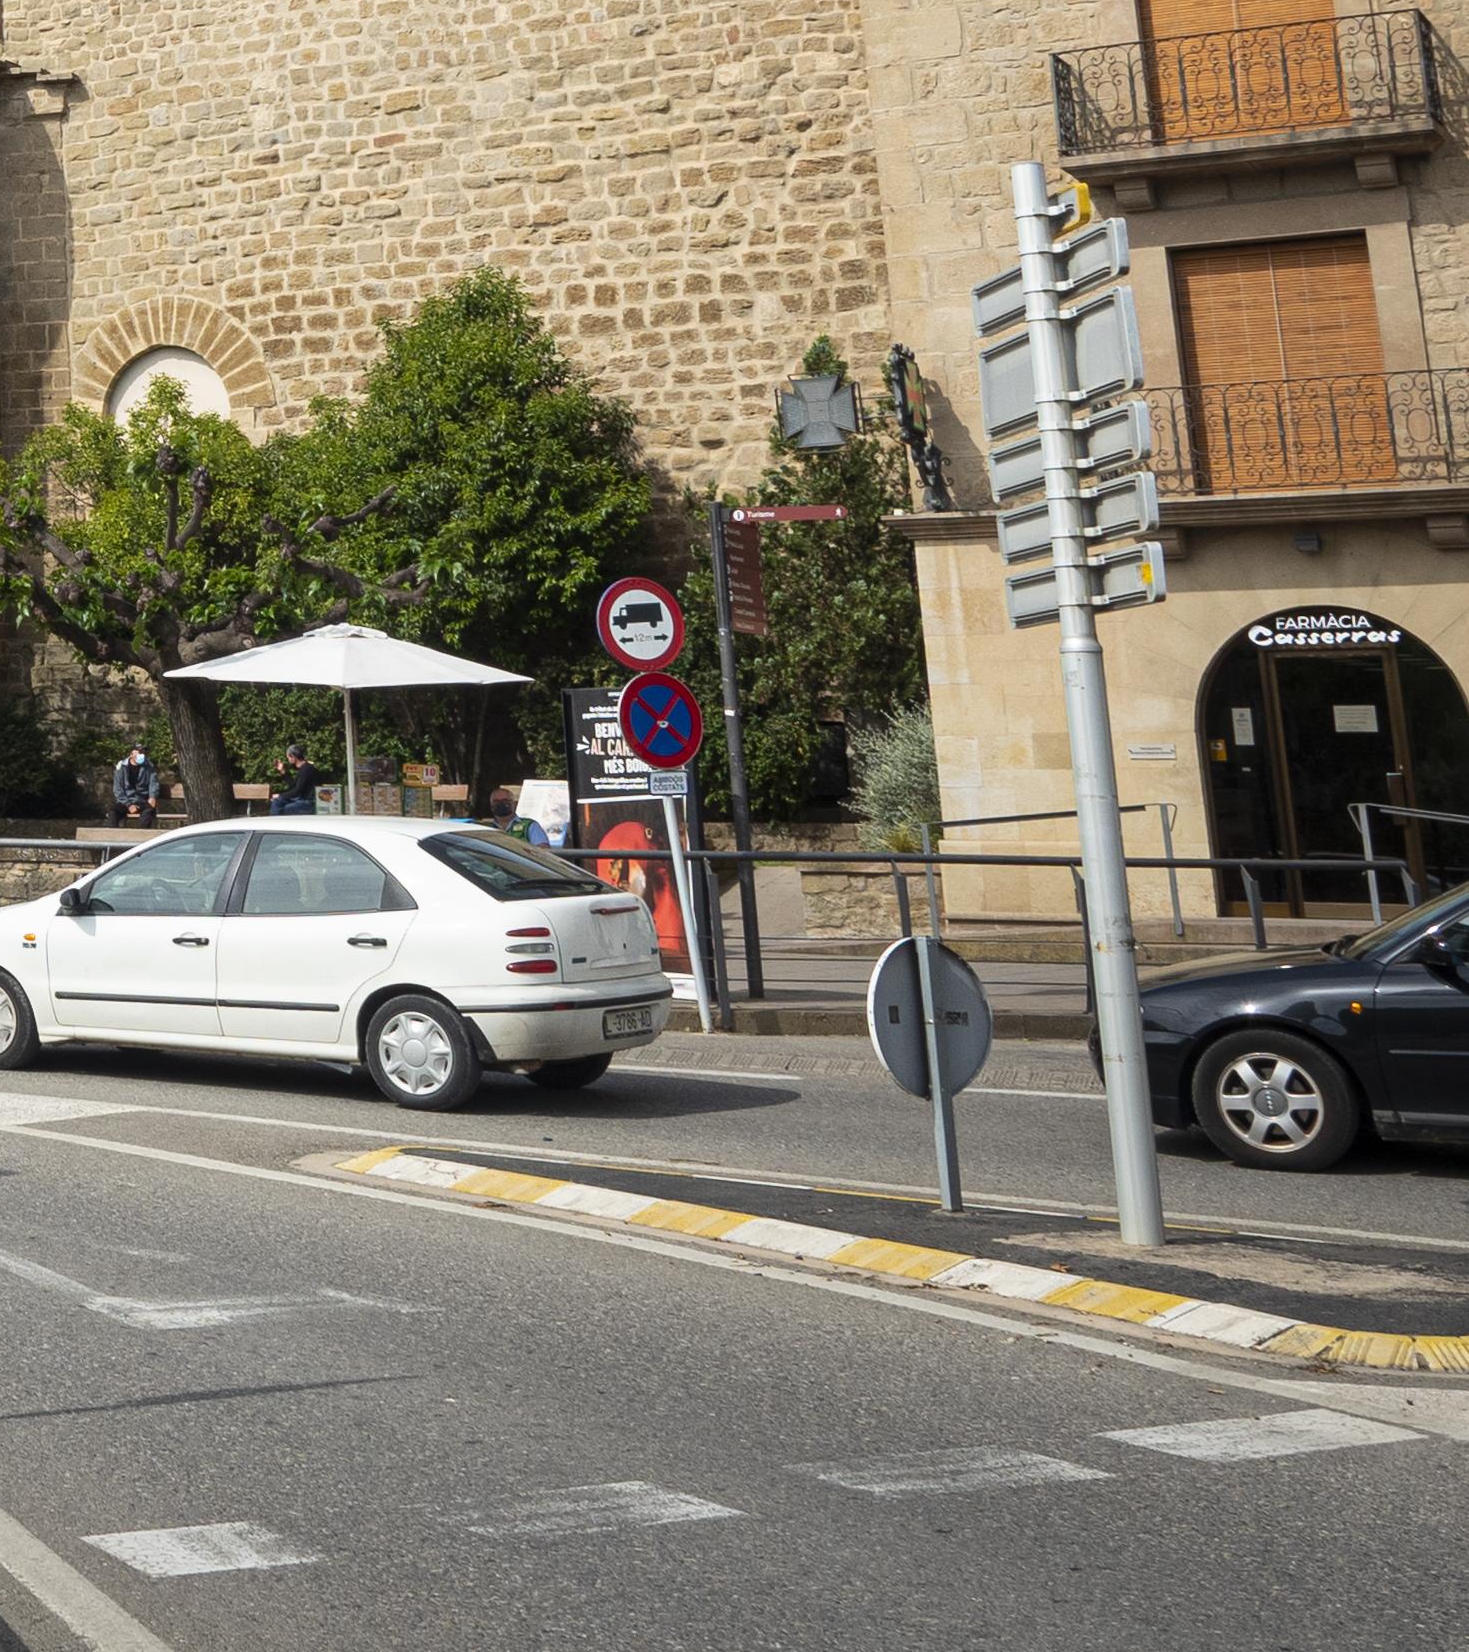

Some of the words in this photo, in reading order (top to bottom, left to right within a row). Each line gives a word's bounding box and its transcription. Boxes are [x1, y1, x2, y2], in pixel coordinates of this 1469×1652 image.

[1276, 613, 1372, 630] FARMÀCIA
[1248, 625, 1401, 646] Casserras
[590, 738, 605, 755] AL
[604, 756, 625, 774] MÉS
